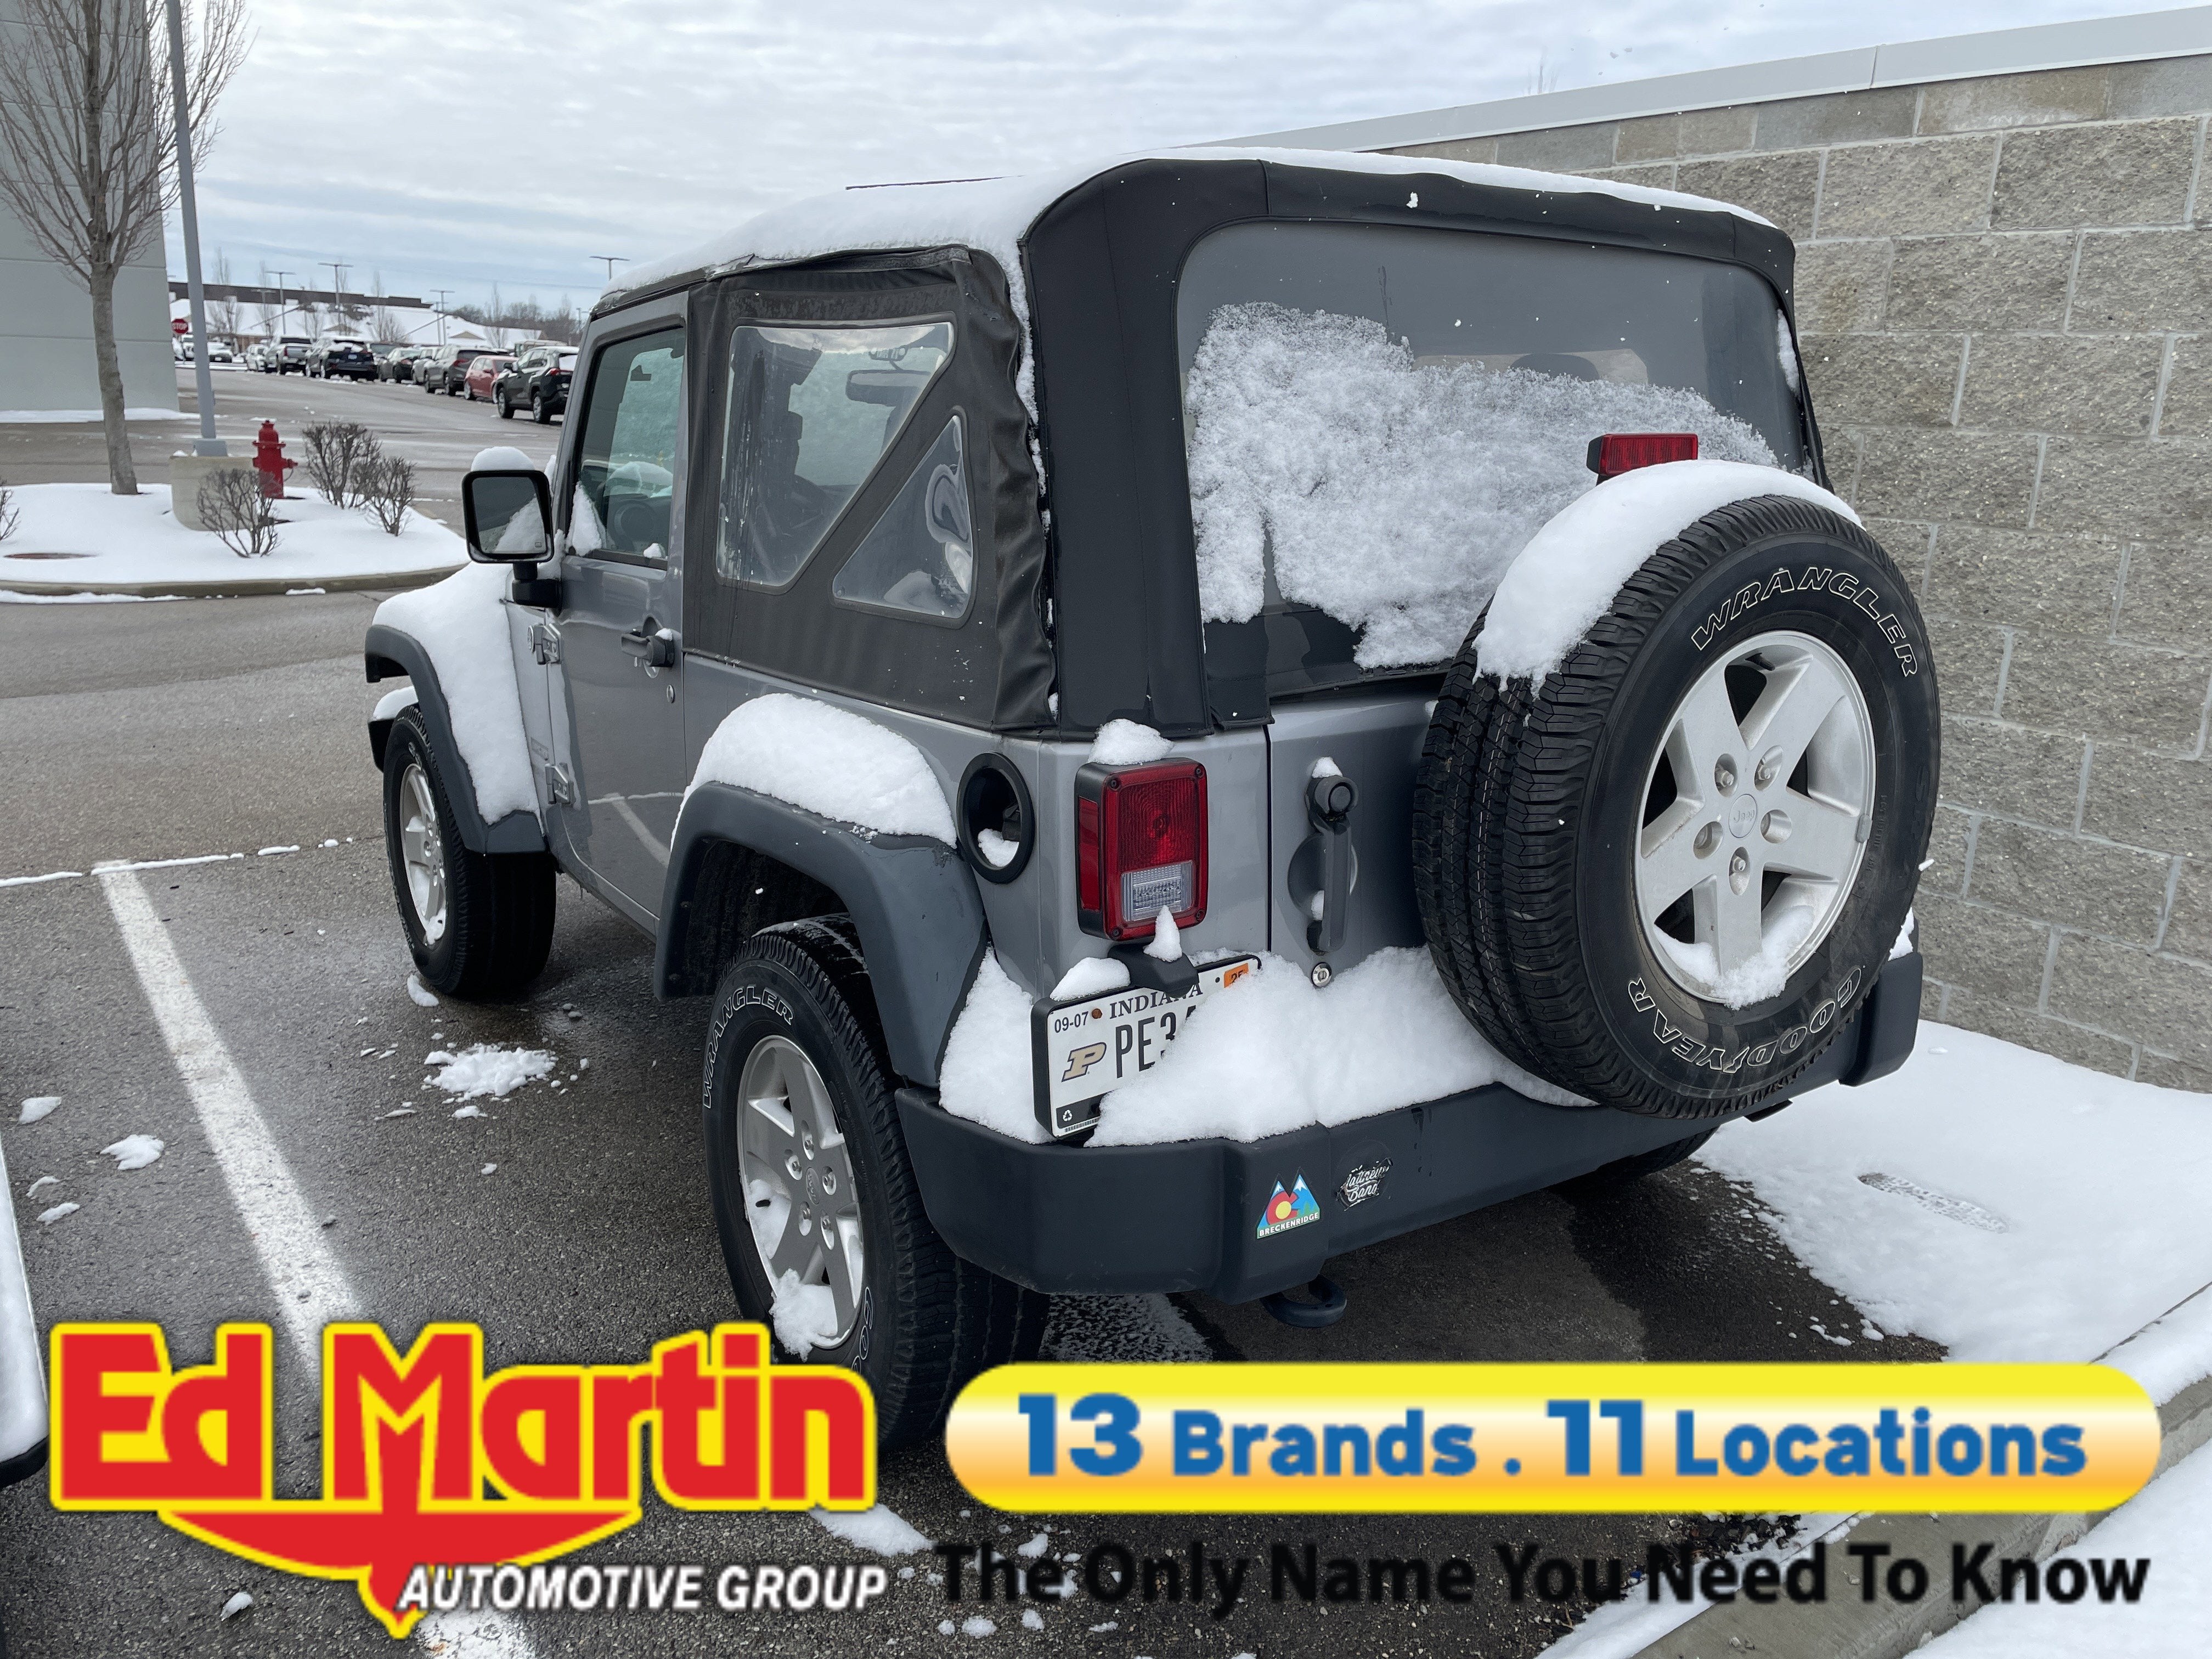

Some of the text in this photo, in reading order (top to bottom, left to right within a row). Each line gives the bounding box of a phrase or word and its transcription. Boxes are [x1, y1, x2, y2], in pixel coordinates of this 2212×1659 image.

[1690, 566, 1918, 678] WRANGLER
[1733, 809, 1756, 822] Jeep
[1054, 1011, 1089, 1034] 09-07
[1109, 983, 1204, 1019] INDIAA
[1627, 966, 1863, 1074] GOODYEAR
[702, 985, 795, 1109] WRANGLER
[1115, 1005, 1197, 1079] PE3
[1259, 1212, 1319, 1237] BRECKENRIDGE
